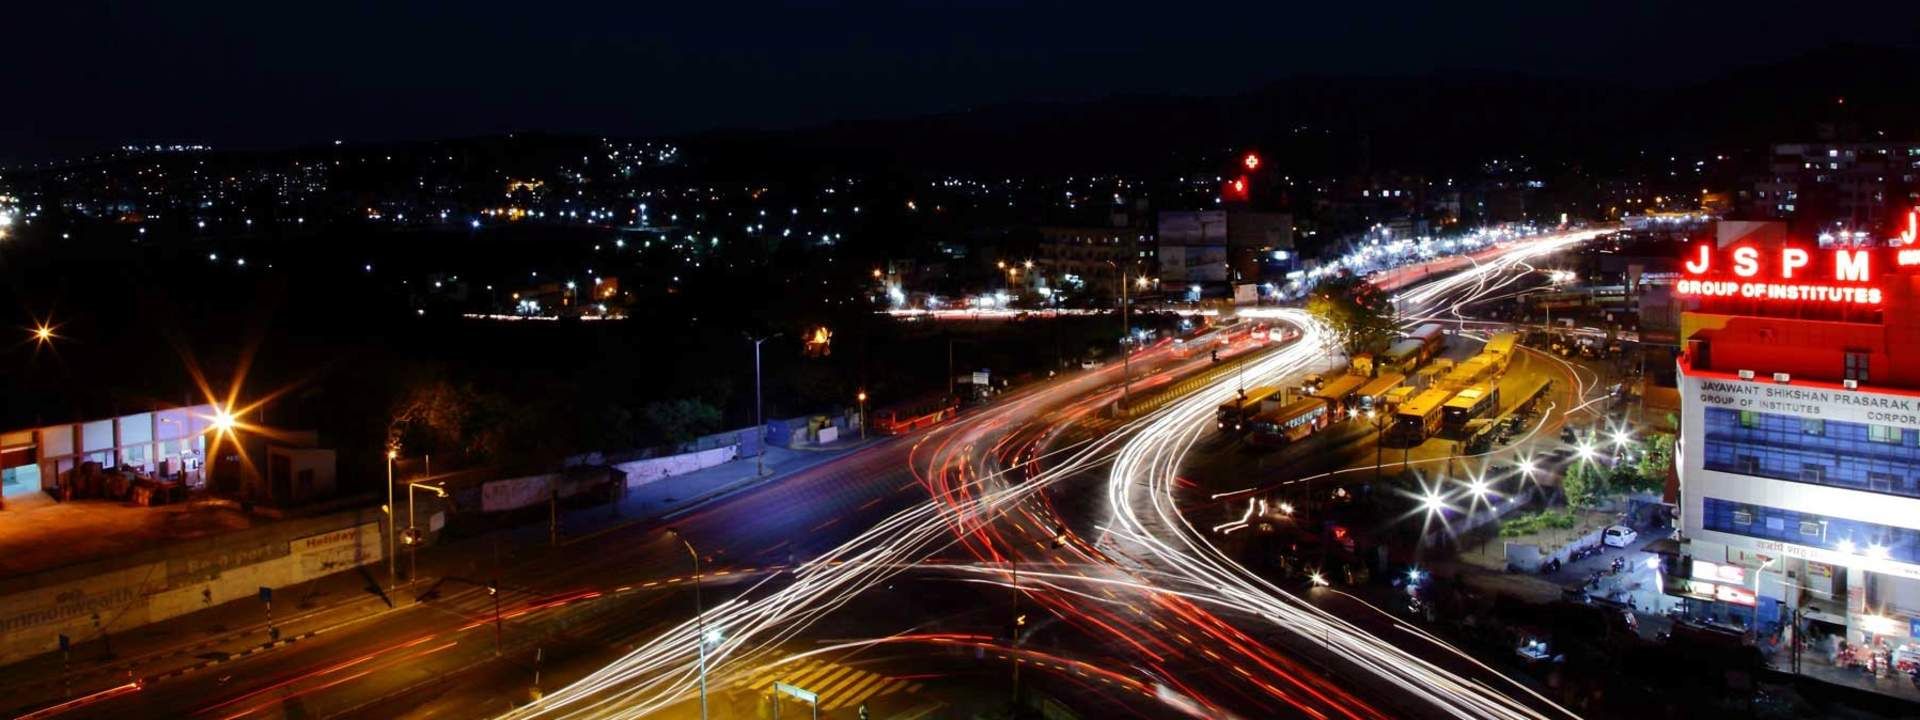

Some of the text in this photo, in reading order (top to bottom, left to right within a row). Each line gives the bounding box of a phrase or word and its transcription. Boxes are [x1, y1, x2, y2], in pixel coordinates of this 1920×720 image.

[1677, 280, 1882, 303] GROUP OF INSTITUTES
[1700, 381, 1759, 395] JAYAWANT
[1766, 388, 1828, 402] SHIKSHAN
[1834, 394, 1909, 411] PRASARAK
[1700, 394, 1820, 414] GROUP OF INSTITUTES
[306, 531, 356, 548] Holiday
